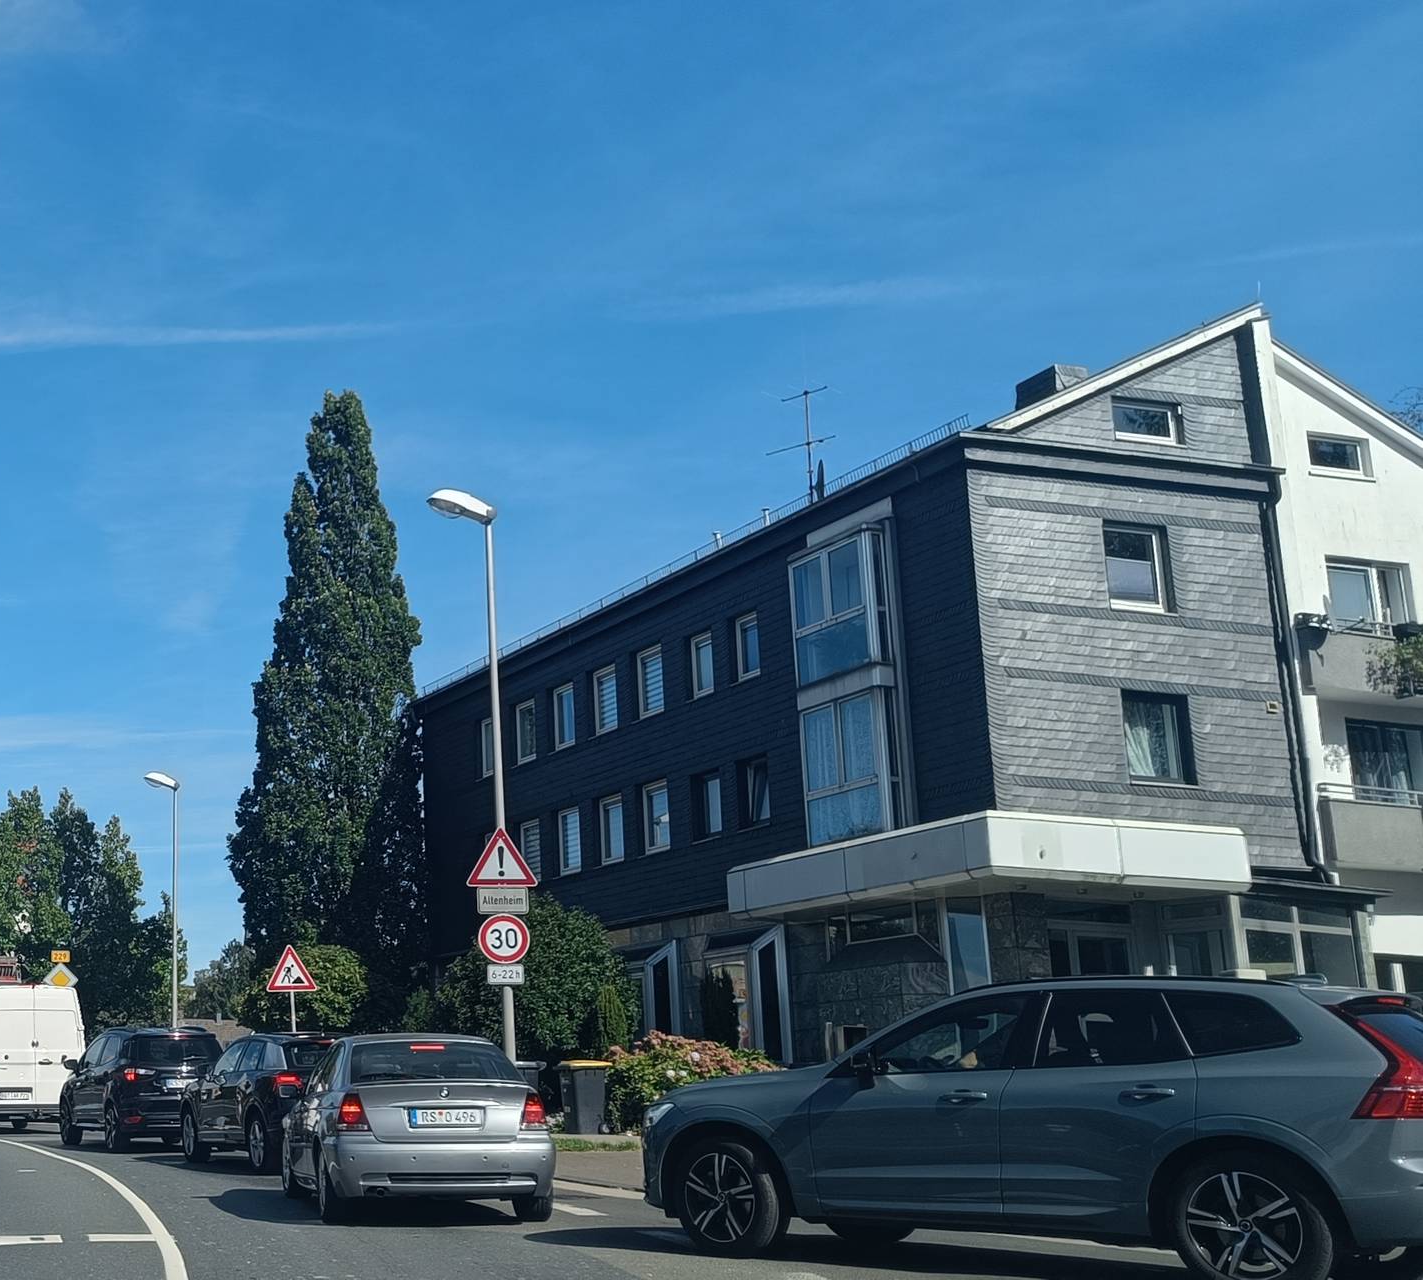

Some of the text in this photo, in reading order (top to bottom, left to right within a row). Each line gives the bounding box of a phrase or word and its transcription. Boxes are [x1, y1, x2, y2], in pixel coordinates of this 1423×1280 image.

[482, 895, 524, 906] Altenheim
[489, 928, 518, 949] 30
[53, 952, 67, 961] 229
[421, 1111, 437, 1123] RS
[455, 1111, 476, 1123] 496
